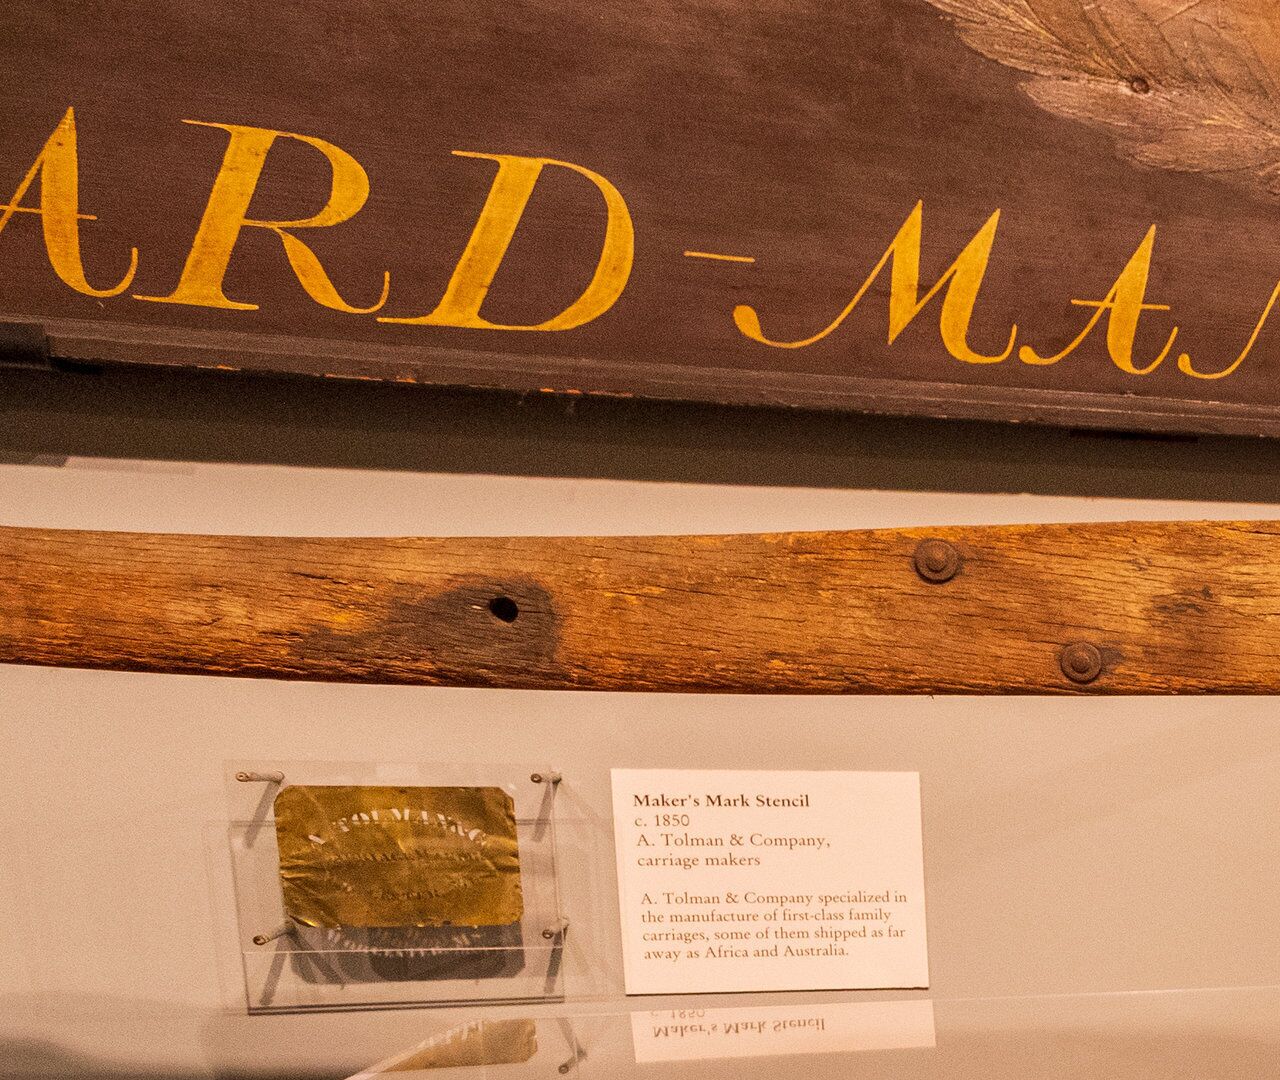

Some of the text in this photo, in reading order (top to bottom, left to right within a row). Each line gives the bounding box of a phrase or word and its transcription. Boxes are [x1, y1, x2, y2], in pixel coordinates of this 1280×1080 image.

[633, 793, 809, 807] Maker's Mark Stencil
[634, 813, 690, 827] c. 1850
[636, 832, 830, 850] A. Tolman & Company,
[637, 852, 761, 870] carriage makers
[640, 890, 907, 907] A. Tolman & Company specialized in
[641, 907, 891, 923] the manufacture of first-class family
[642, 925, 906, 944] carriages, some of them shipped as far
[644, 943, 849, 962] away as Africa and Australia.
